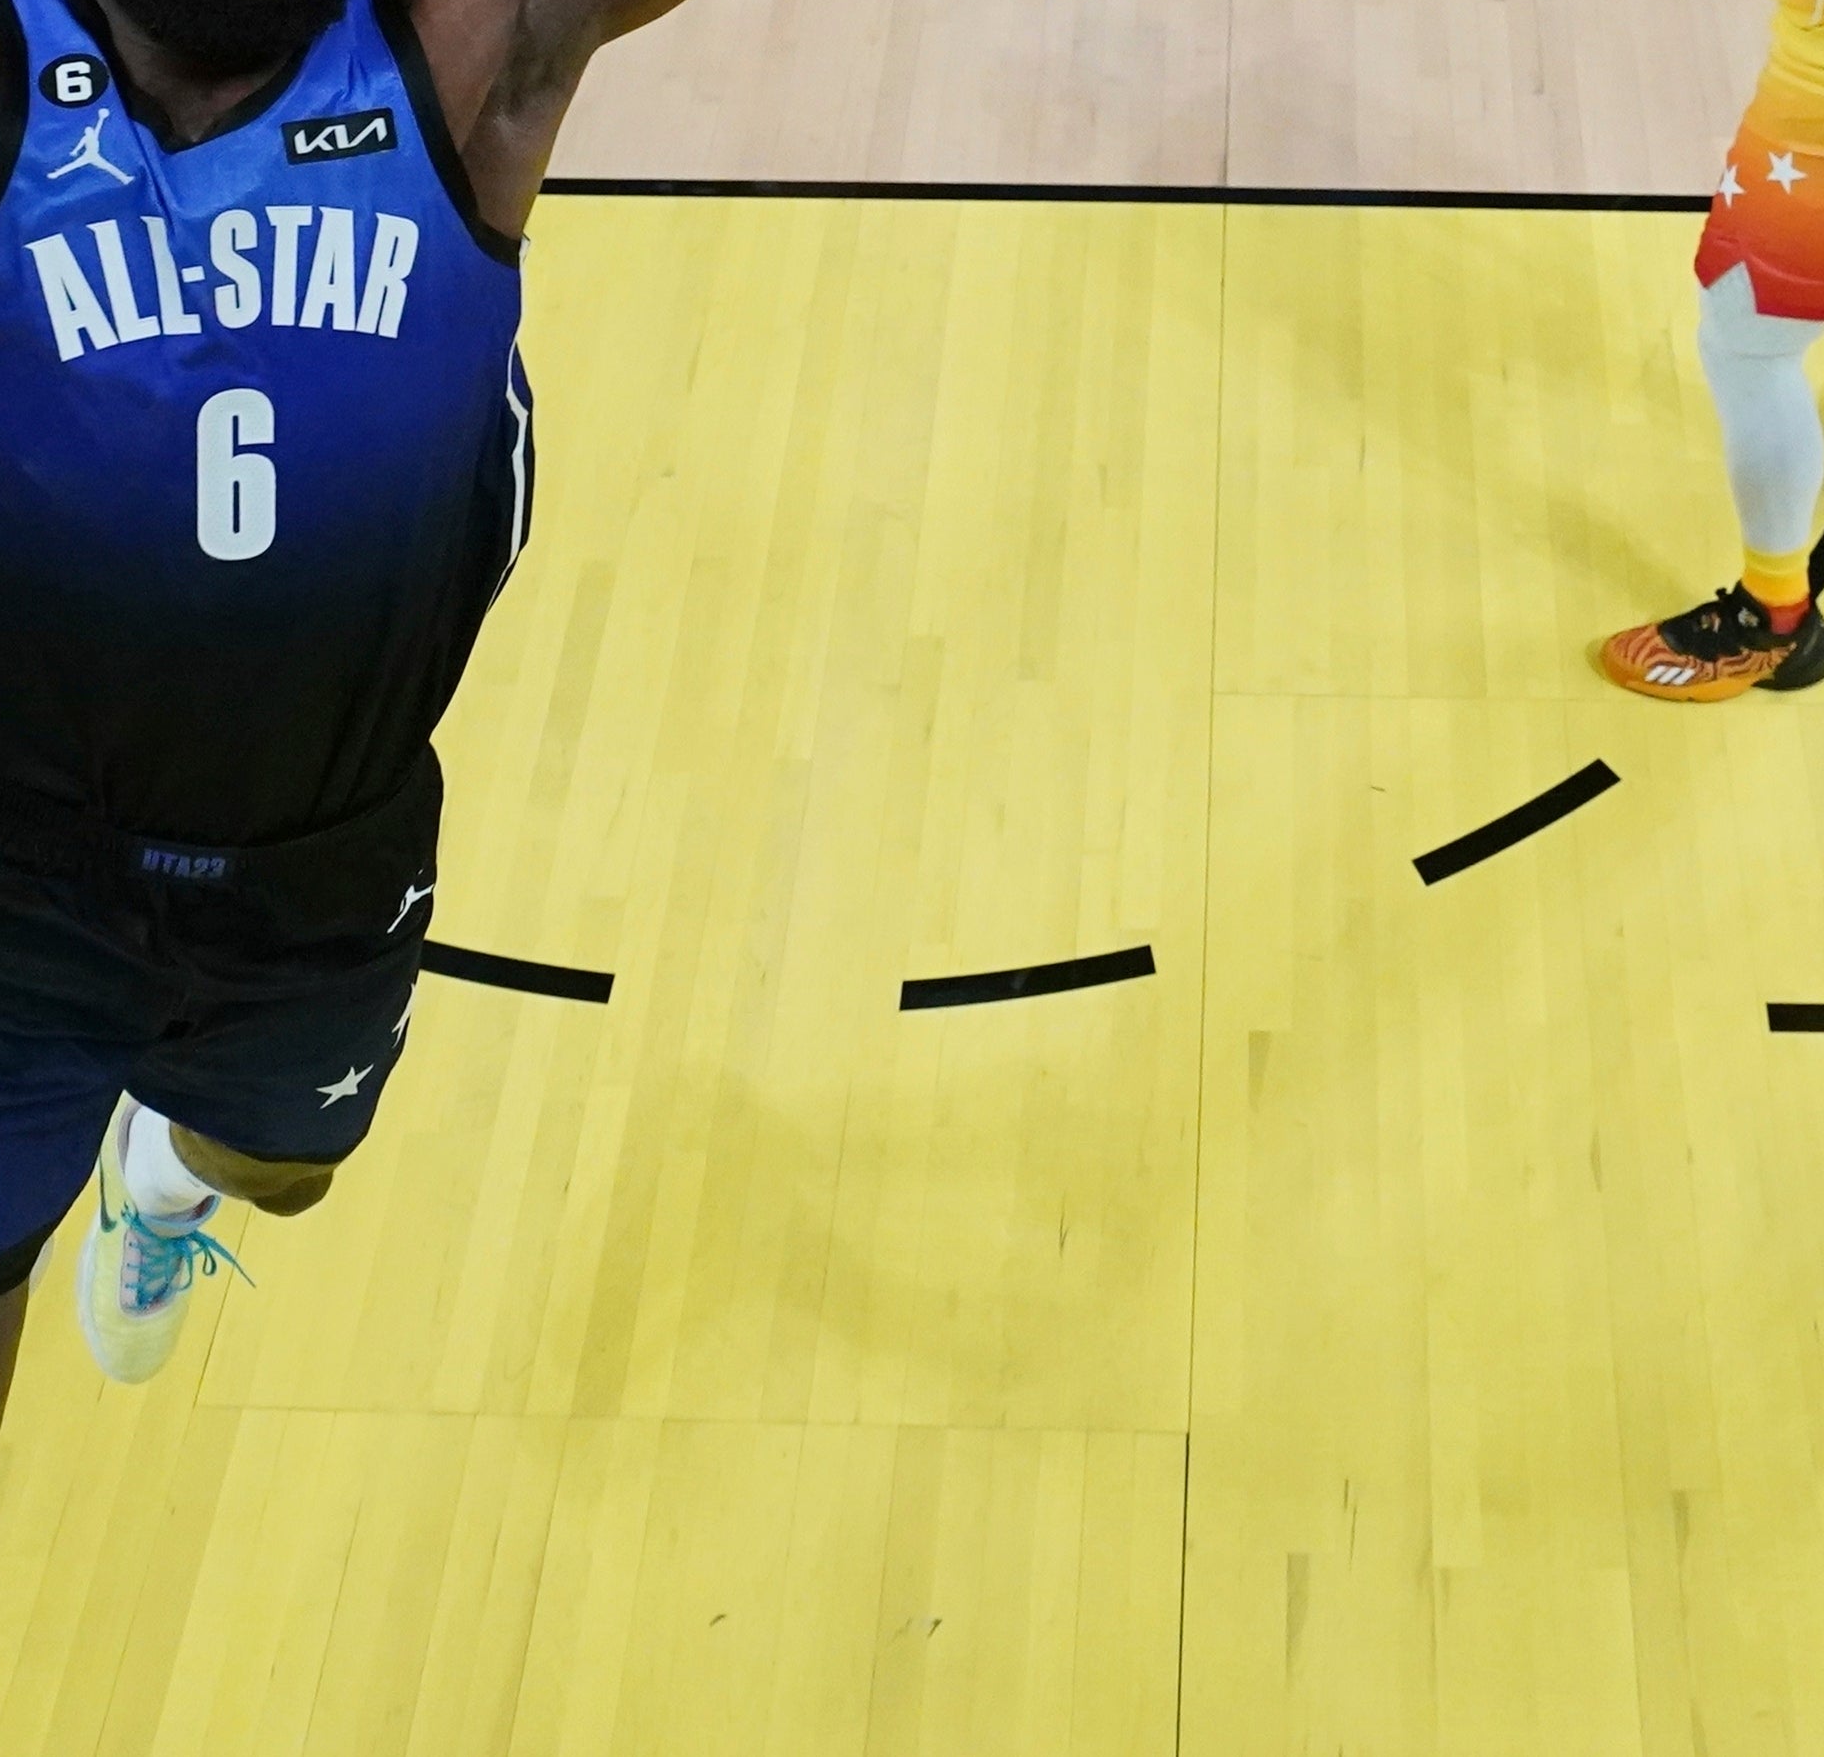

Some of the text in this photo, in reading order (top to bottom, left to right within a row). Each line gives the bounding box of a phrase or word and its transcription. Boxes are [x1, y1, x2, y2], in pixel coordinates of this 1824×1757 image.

[55, 61, 93, 103] 6
[293, 116, 388, 155] KIA
[24, 205, 419, 363] ALL-STAR
[196, 388, 277, 561] 6
[141, 847, 227, 880] UTA23
